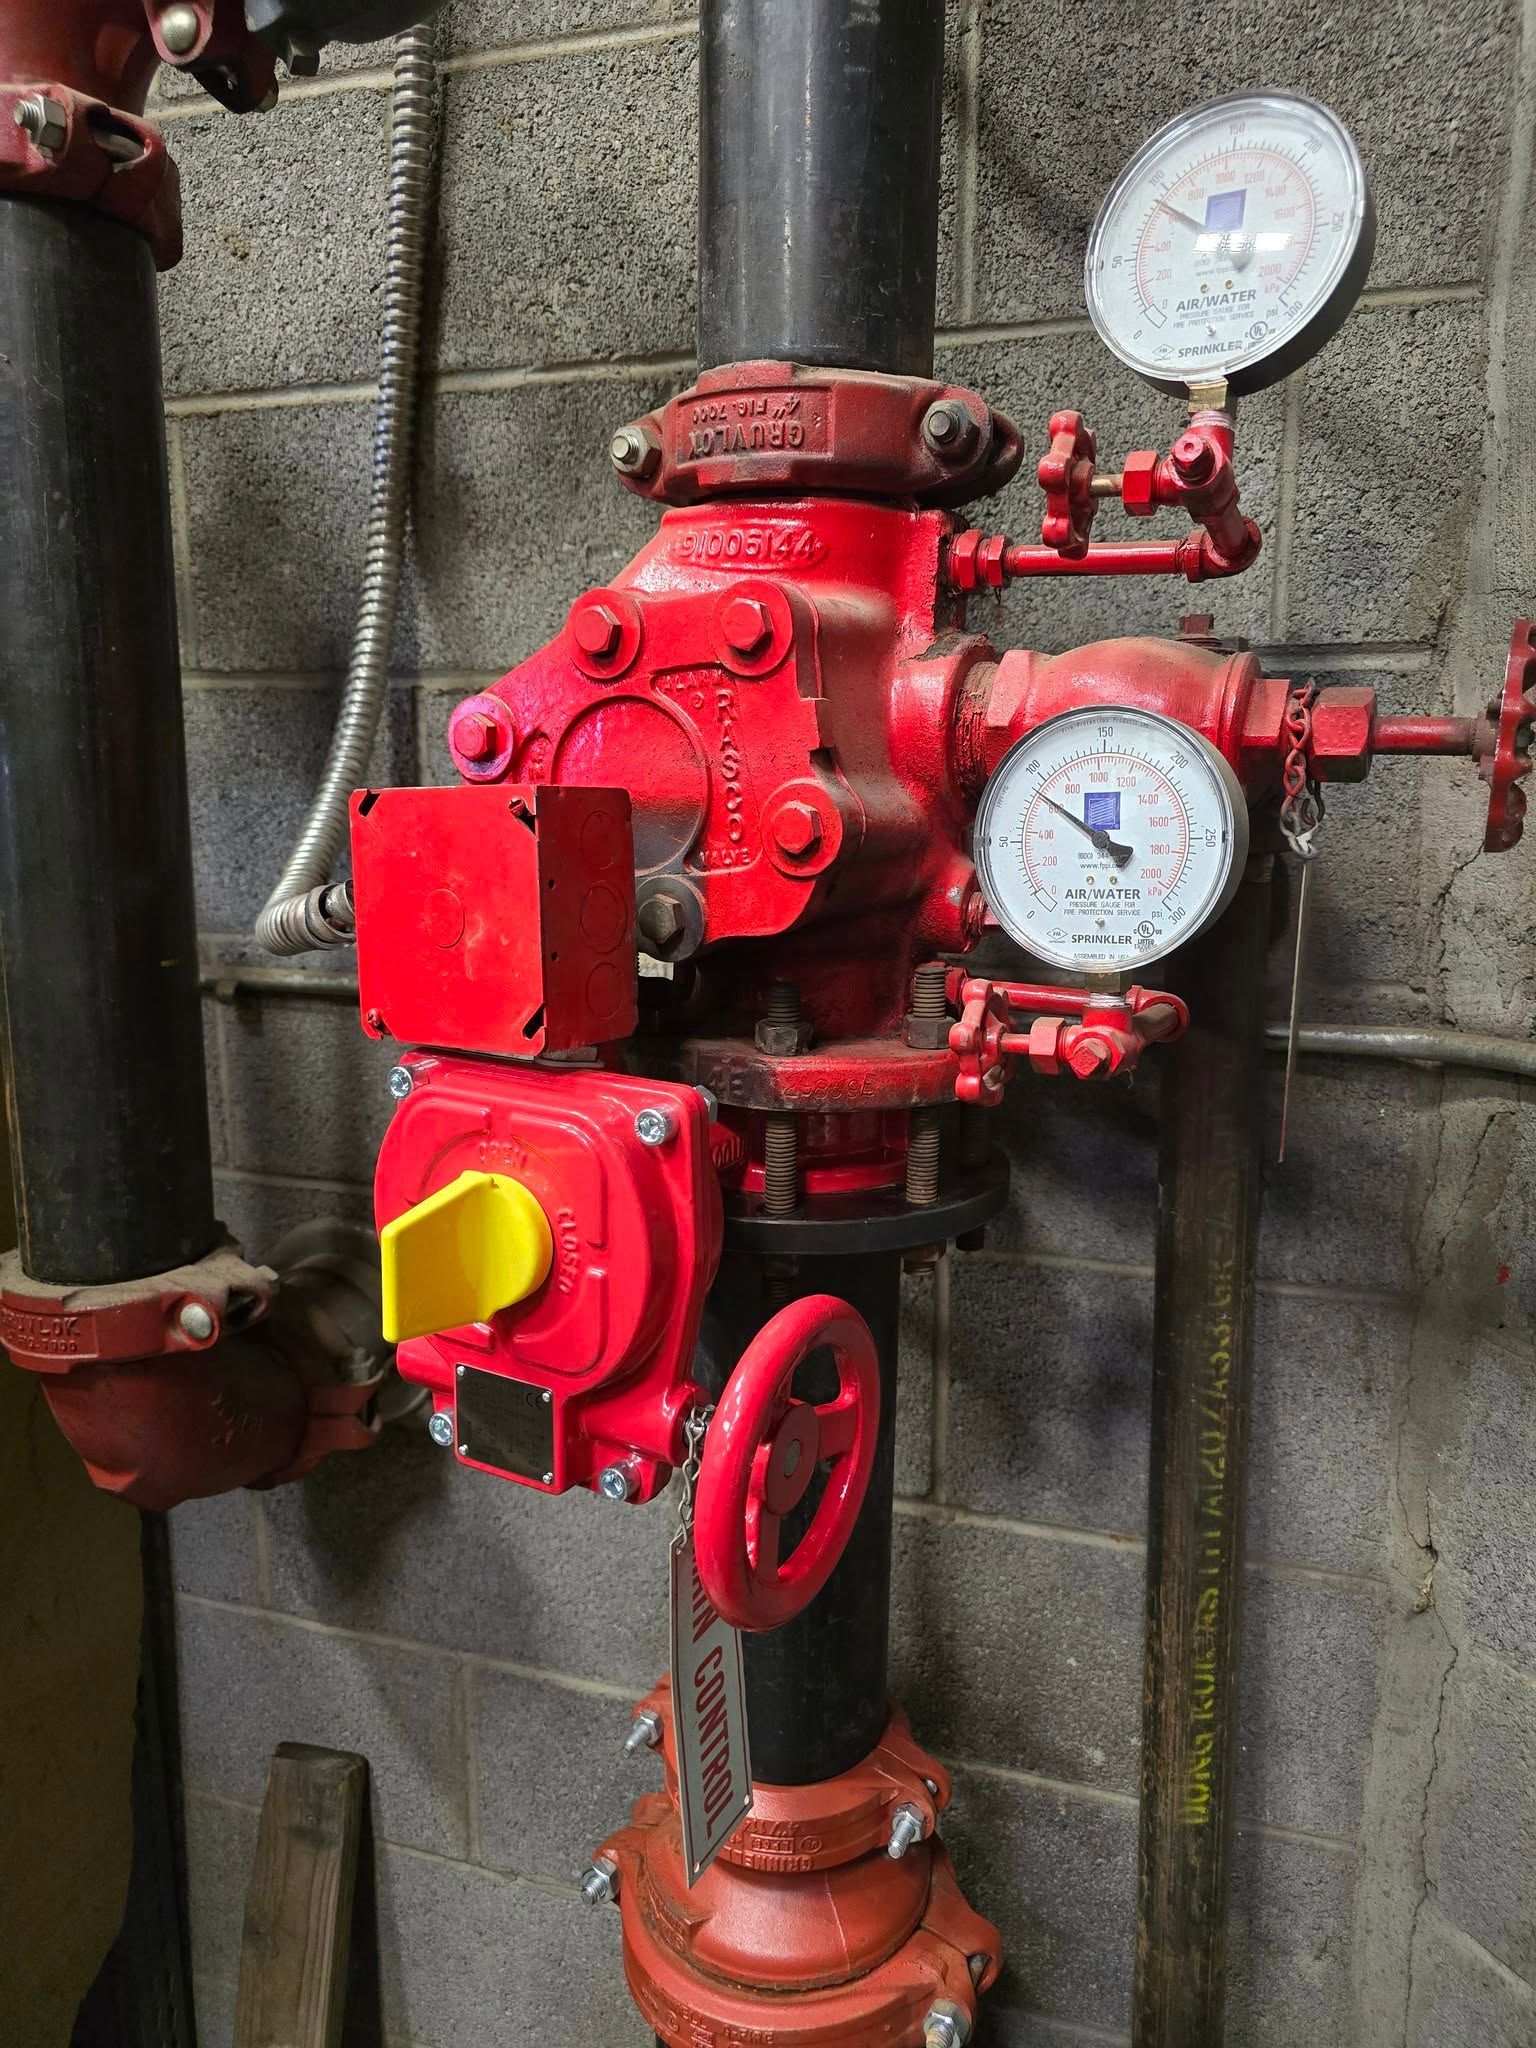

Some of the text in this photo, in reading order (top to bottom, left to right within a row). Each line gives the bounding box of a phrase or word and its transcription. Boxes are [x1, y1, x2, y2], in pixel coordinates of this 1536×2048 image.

[1229, 122, 1246, 136] 150
[1148, 169, 1165, 187] 100
[1154, 240, 1172, 253] 400
[1111, 255, 1123, 269] 50
[1156, 268, 1172, 281] 200
[1258, 263, 1282, 278] 2000
[1264, 282, 1280, 294] kPa
[1175, 289, 1257, 312] AIR/WATER
[1179, 310, 1209, 320] PRESSURE
[1265, 307, 1278, 320] psi
[1283, 300, 1303, 318] 300
[1177, 340, 1243, 359] SPRINKLER
[687, 420, 804, 460] GRUVLOK
[1097, 726, 1113, 737] 150
[1170, 751, 1188, 769] 200
[1025, 759, 1041, 775] 100
[1089, 772, 1108, 782] 1000
[1116, 777, 1136, 787] 1200
[1064, 784, 1080, 794] 800
[1138, 794, 1158, 805] 1400
[1148, 816, 1169, 827] 1600
[1038, 829, 1054, 840] 400
[1205, 828, 1216, 848] 250
[998, 836, 1009, 848] 50
[1149, 844, 1170, 855] 1800
[1042, 856, 1058, 867] 200
[1140, 868, 1162, 879] 2000
[1051, 884, 1057, 895] 0
[1064, 888, 1141, 901] AIR/WATER
[1147, 886, 1162, 896] kPa
[1026, 909, 1035, 920] 0
[1063, 908, 1075, 916] FIRE
[1078, 908, 1114, 916] PROTECTION
[1151, 908, 1163, 920] psi
[1168, 906, 1186, 925] 300
[1071, 934, 1132, 945] SPRINKLER
[556, 1207, 578, 1296] CLOSED
[694, 1645, 734, 1840] CONTROL
